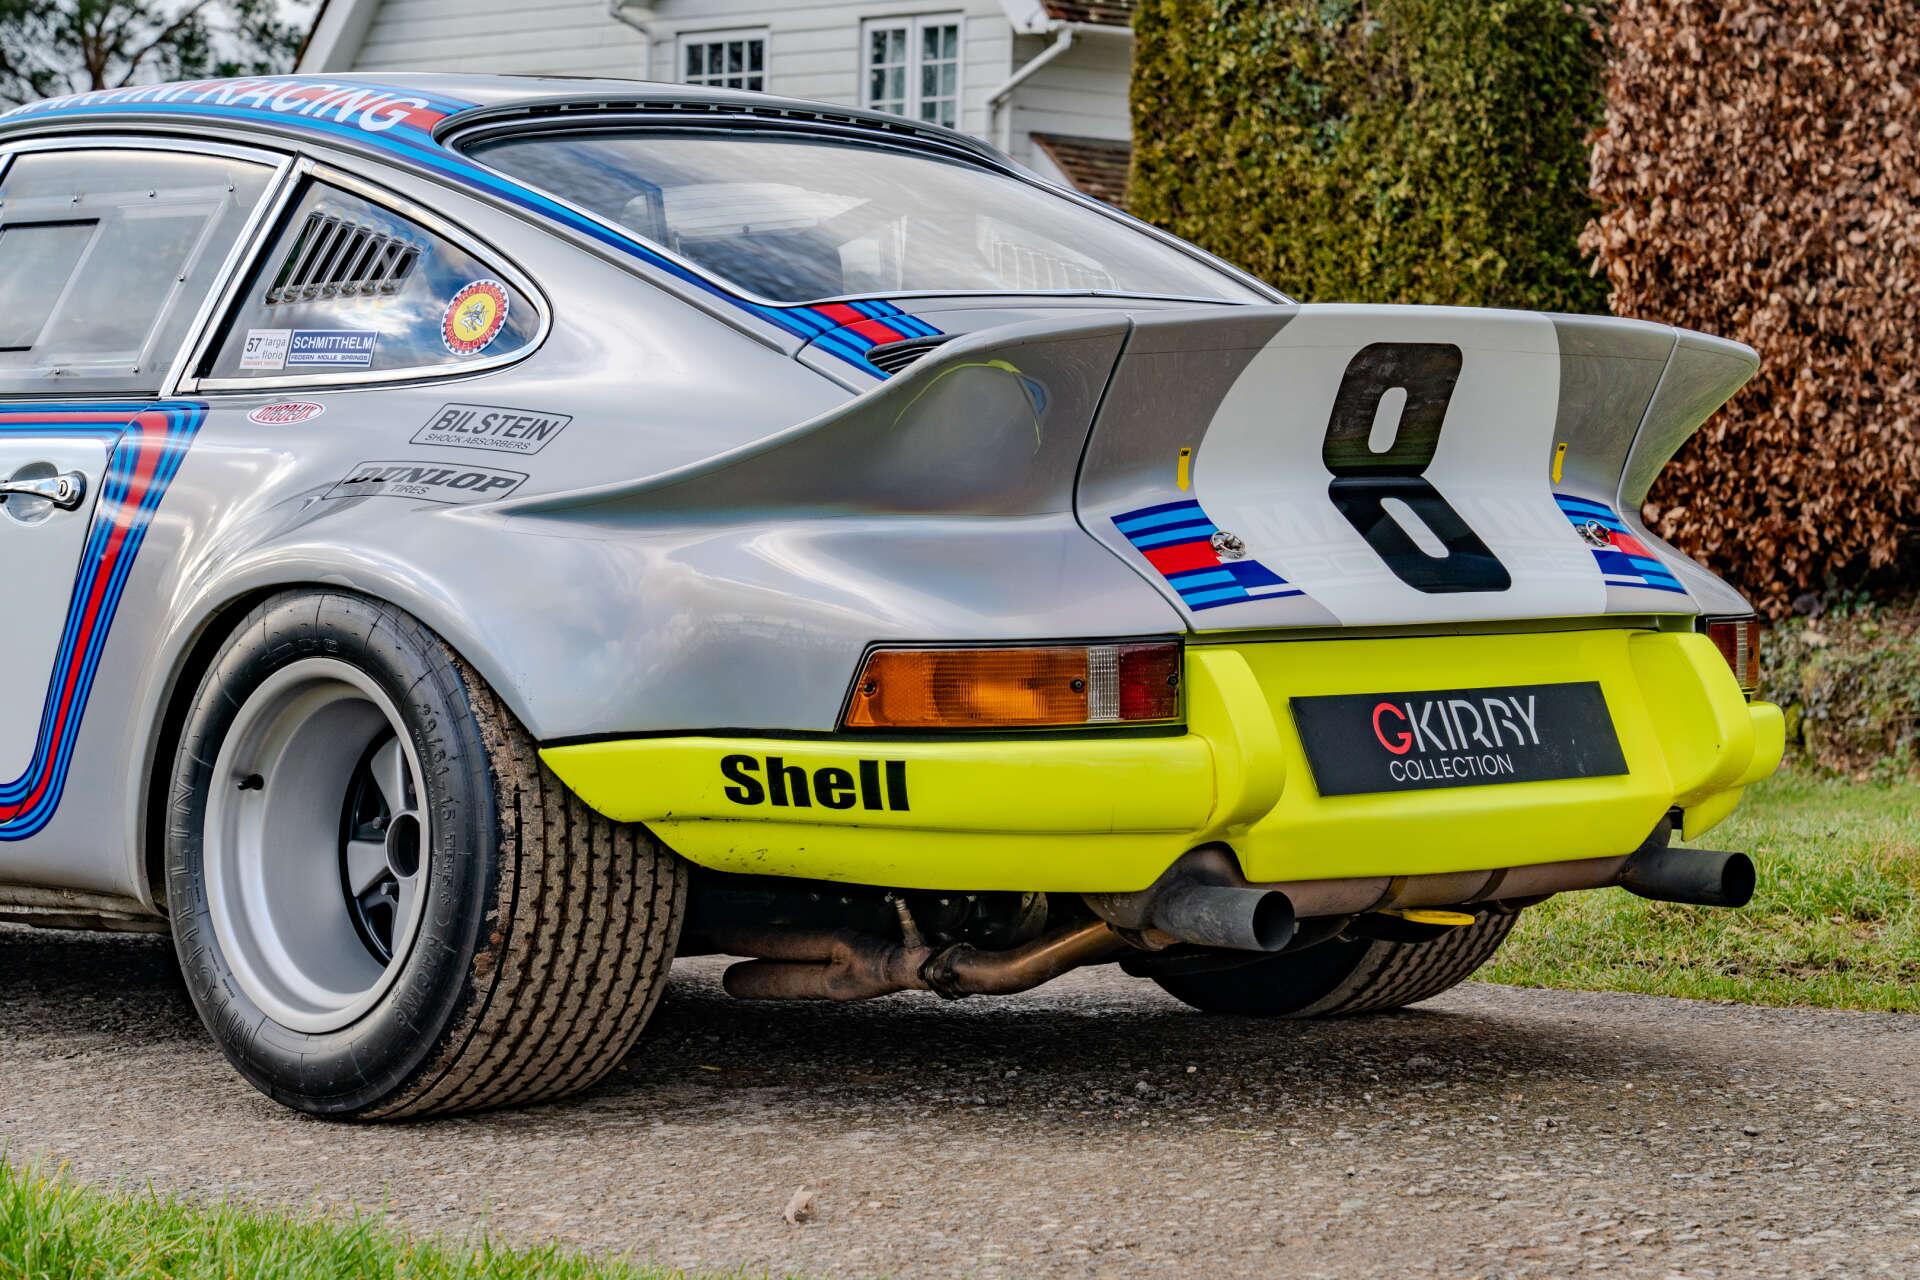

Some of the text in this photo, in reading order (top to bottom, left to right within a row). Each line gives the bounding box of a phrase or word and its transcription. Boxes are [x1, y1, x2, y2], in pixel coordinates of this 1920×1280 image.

[193, 79, 429, 132] RACING
[262, 350, 283, 360] florio
[292, 336, 374, 349] SCHMITTHELM
[430, 409, 560, 441] BILSTEIN
[424, 433, 532, 450] SHOCK ABSORBERS
[343, 466, 518, 492] DUNLOP
[1321, 342, 1512, 594] 8
[389, 484, 430, 496] TIRES
[1389, 753, 1515, 782] COLLECTION
[720, 754, 911, 811] Shell
[167, 779, 256, 1060] MICHELIN
